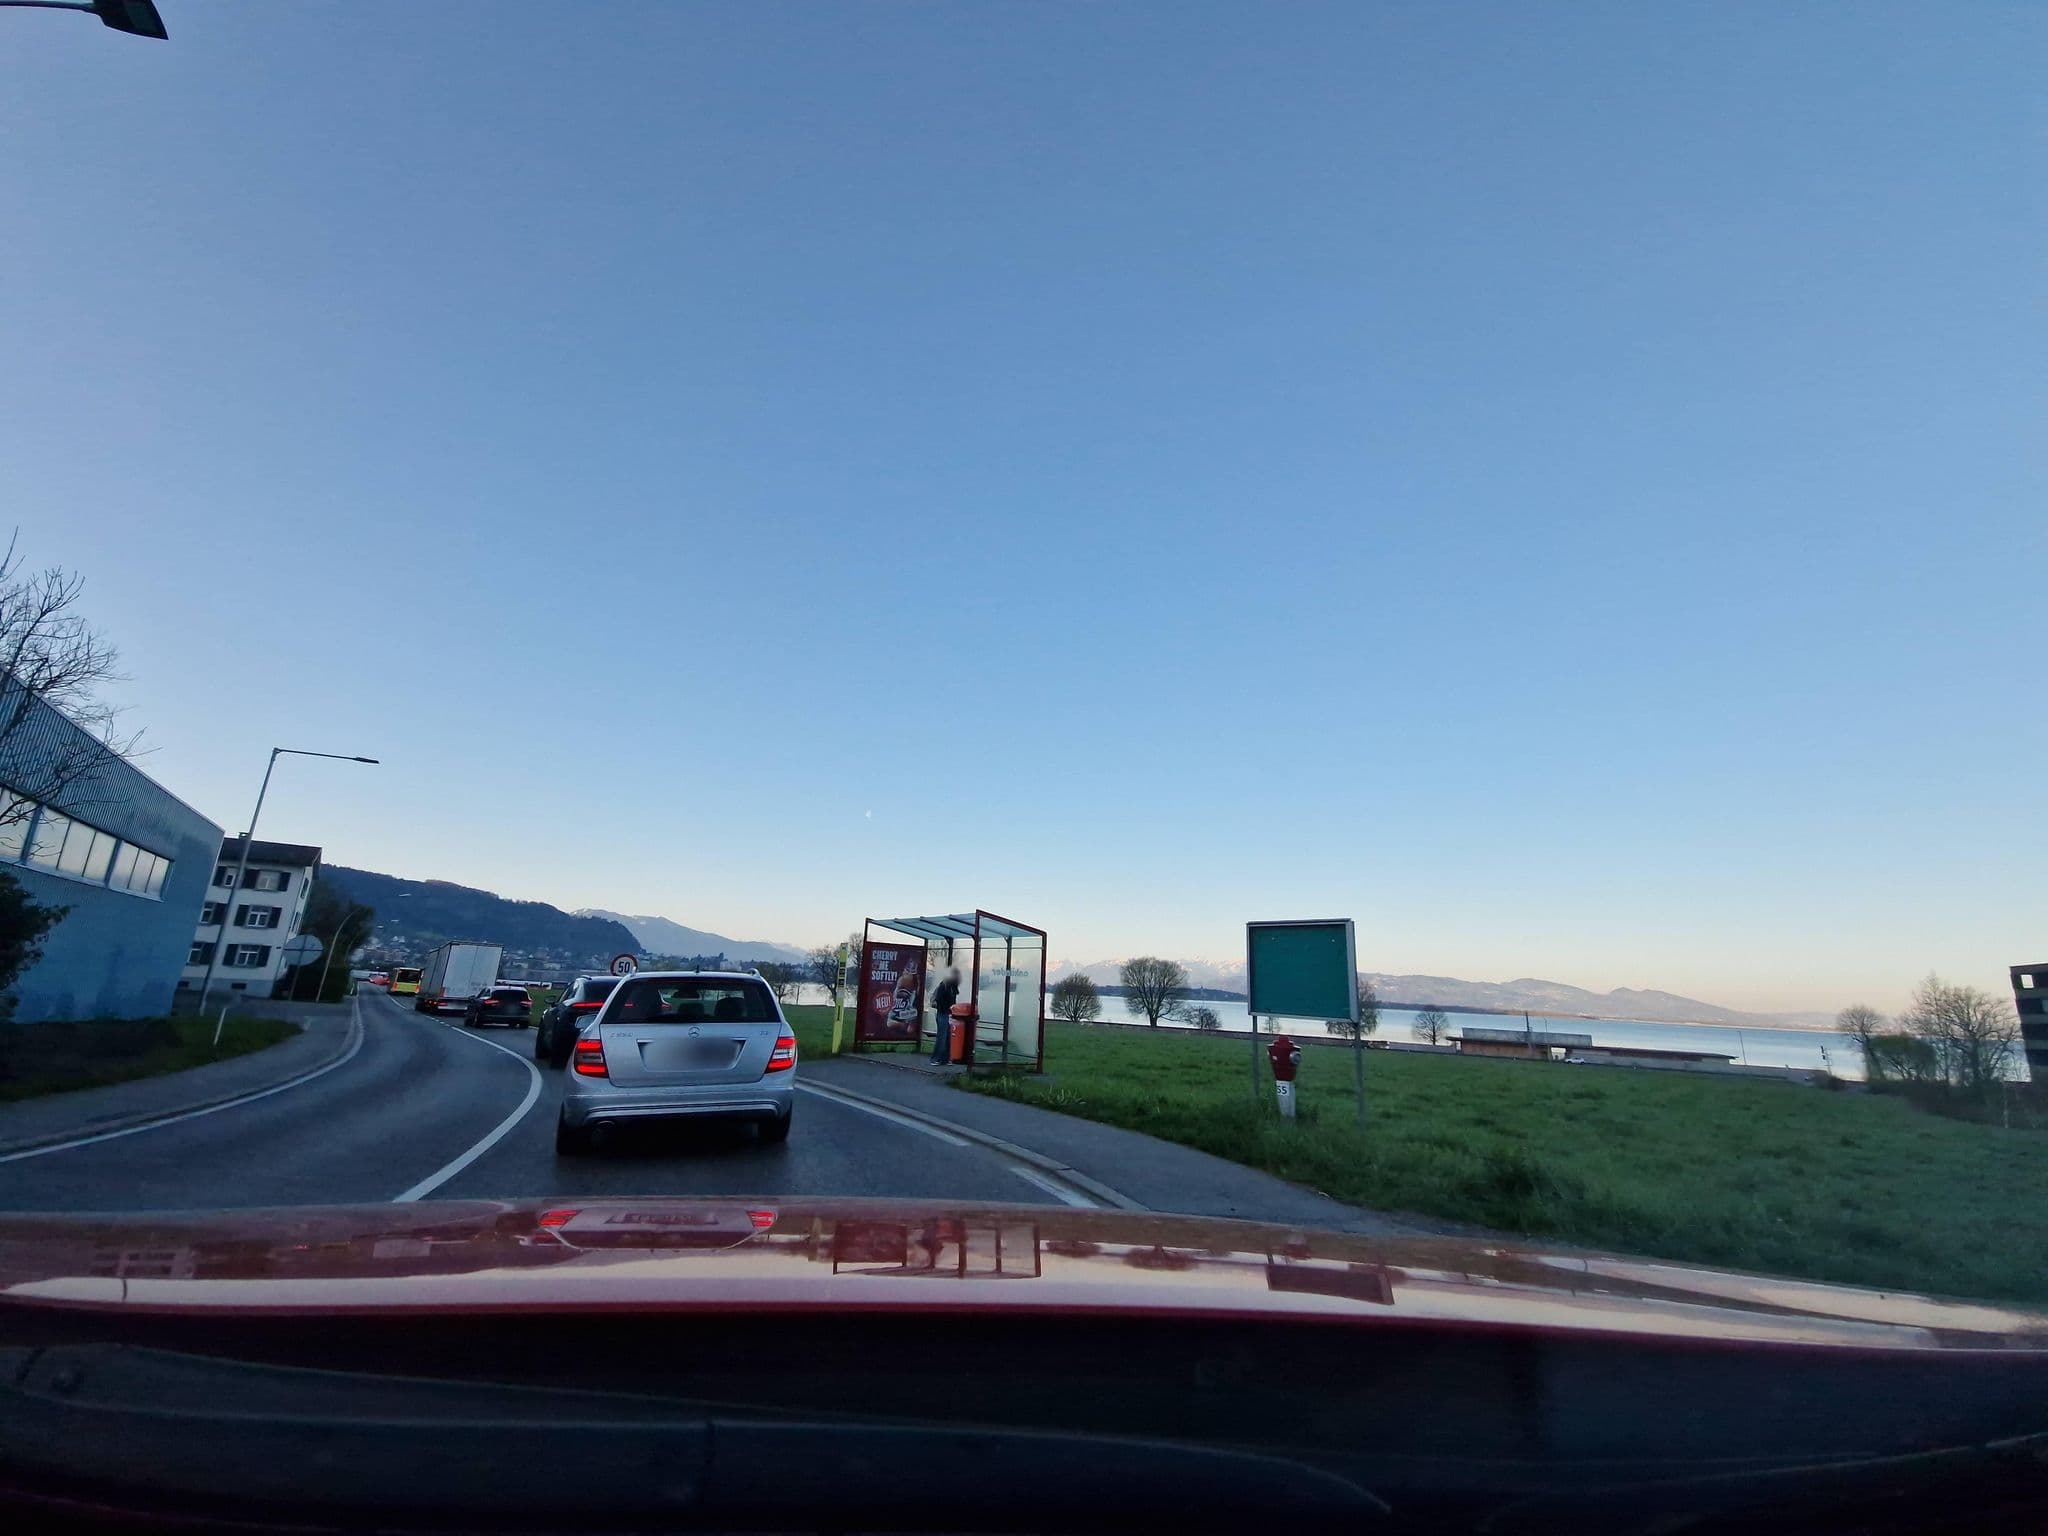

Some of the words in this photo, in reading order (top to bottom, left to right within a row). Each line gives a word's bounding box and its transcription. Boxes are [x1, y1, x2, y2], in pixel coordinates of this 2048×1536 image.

[872, 950, 898, 961] CHERRY
[618, 961, 631, 973] 50
[871, 970, 898, 982] SOFTLY!
